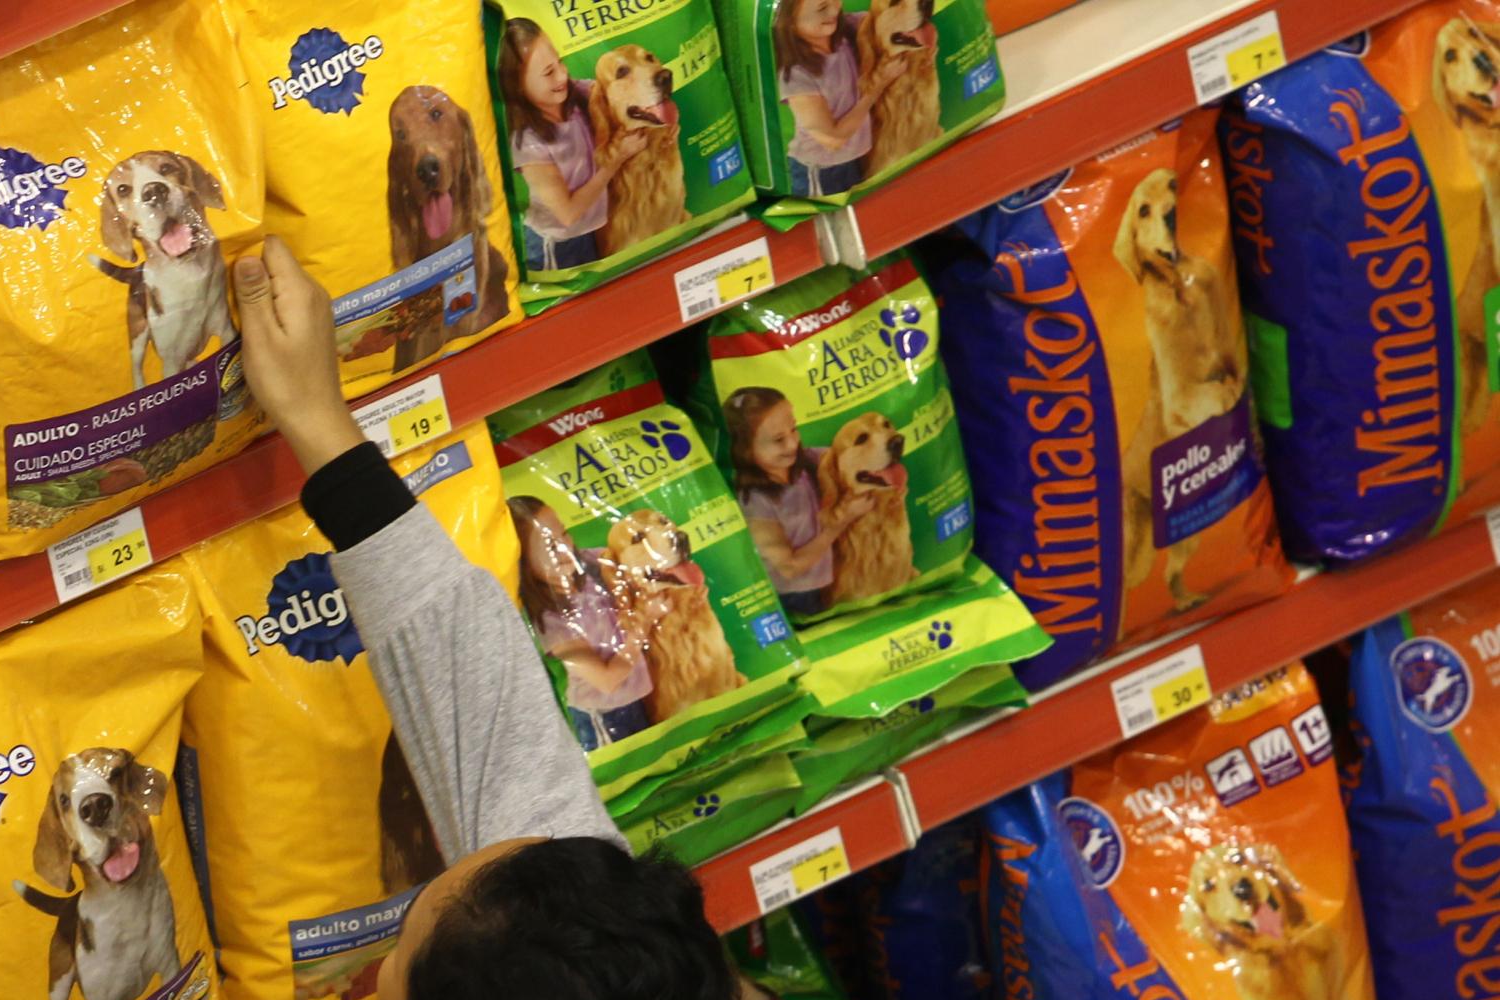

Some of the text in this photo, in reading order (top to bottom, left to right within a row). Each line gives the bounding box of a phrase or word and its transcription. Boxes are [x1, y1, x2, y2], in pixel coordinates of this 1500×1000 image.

[268, 35, 383, 109] Pedigree
[1254, 52, 1262, 69] 7
[365, 281, 402, 299] mayor
[403, 268, 430, 288] vida
[745, 276, 755, 293] 7
[1328, 87, 1442, 496] Mimaskot
[816, 351, 898, 406] PERROS
[13, 370, 208, 448] ADULTO RAZAS PEQUEÑAS
[549, 407, 604, 435] Wong
[410, 418, 431, 438] 19
[995, 239, 1101, 637] Mimaskot
[14, 425, 147, 472] CUIDADO ESPECIAL
[1161, 444, 1211, 488] pollo
[14, 471, 41, 482] ADULT
[572, 451, 668, 508] PERROS
[1161, 437, 1246, 508] y cereales
[112, 544, 134, 565] 23
[236, 588, 348, 655] Pedig
[1172, 687, 1192, 707] 30
[1298, 717, 1326, 746] 1+
[1123, 770, 1205, 821] 100%
[822, 867, 832, 884] 7
[295, 919, 360, 941] adulto
